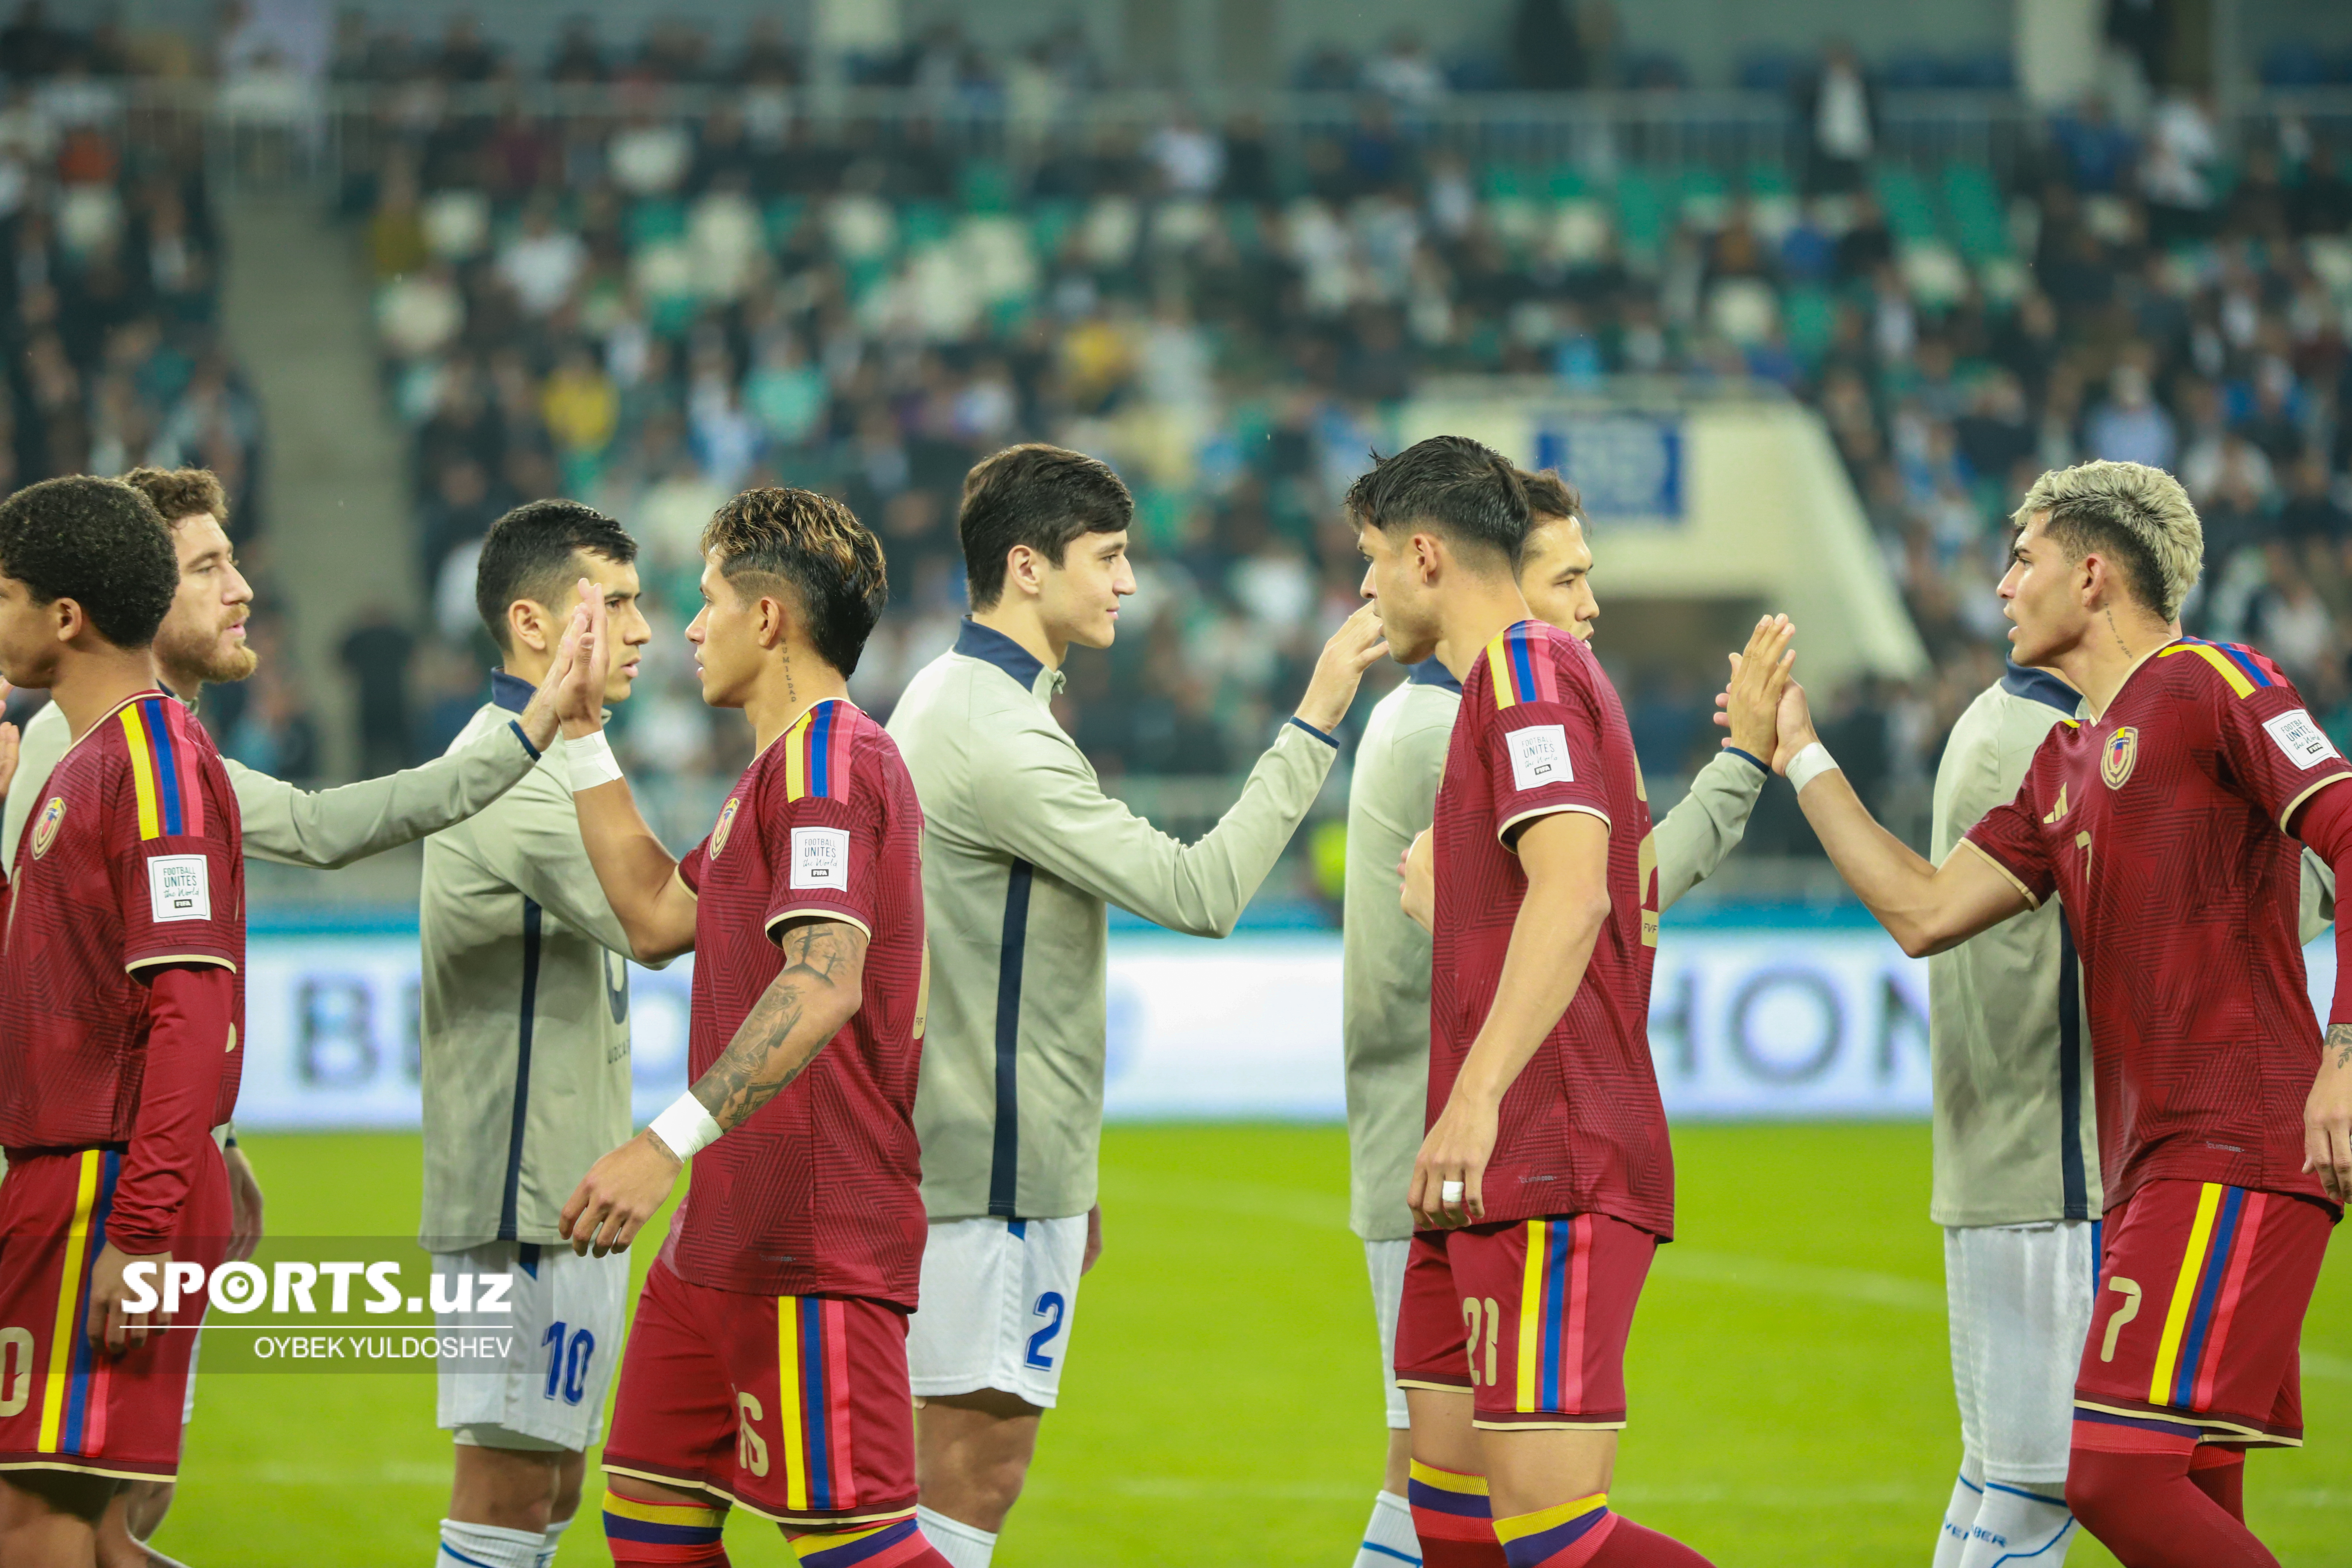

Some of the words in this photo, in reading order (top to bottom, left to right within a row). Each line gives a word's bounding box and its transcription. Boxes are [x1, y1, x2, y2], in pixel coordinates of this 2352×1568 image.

[781, 637, 796, 702] HUMILDAD
[2281, 719, 2304, 733] FOOTBA
[1522, 737, 1553, 748] FOOTBALL
[1523, 744, 1555, 758] UNITES
[2308, 744, 2321, 753] FIFA
[1536, 765, 1551, 774] FIFA
[805, 838, 836, 847] FOOTBALL
[805, 847, 836, 858] UNITES
[803, 858, 813, 867] the
[816, 858, 838, 868] World
[163, 867, 196, 876] FOOTBALL
[164, 875, 197, 888] UNITES
[163, 889, 176, 898] the
[178, 887, 200, 897] World
[1644, 923, 1657, 934] FVF
[2100, 1276, 2142, 1363] 7
[1023, 1291, 1066, 1372] 2
[541, 1321, 596, 1406] 10
